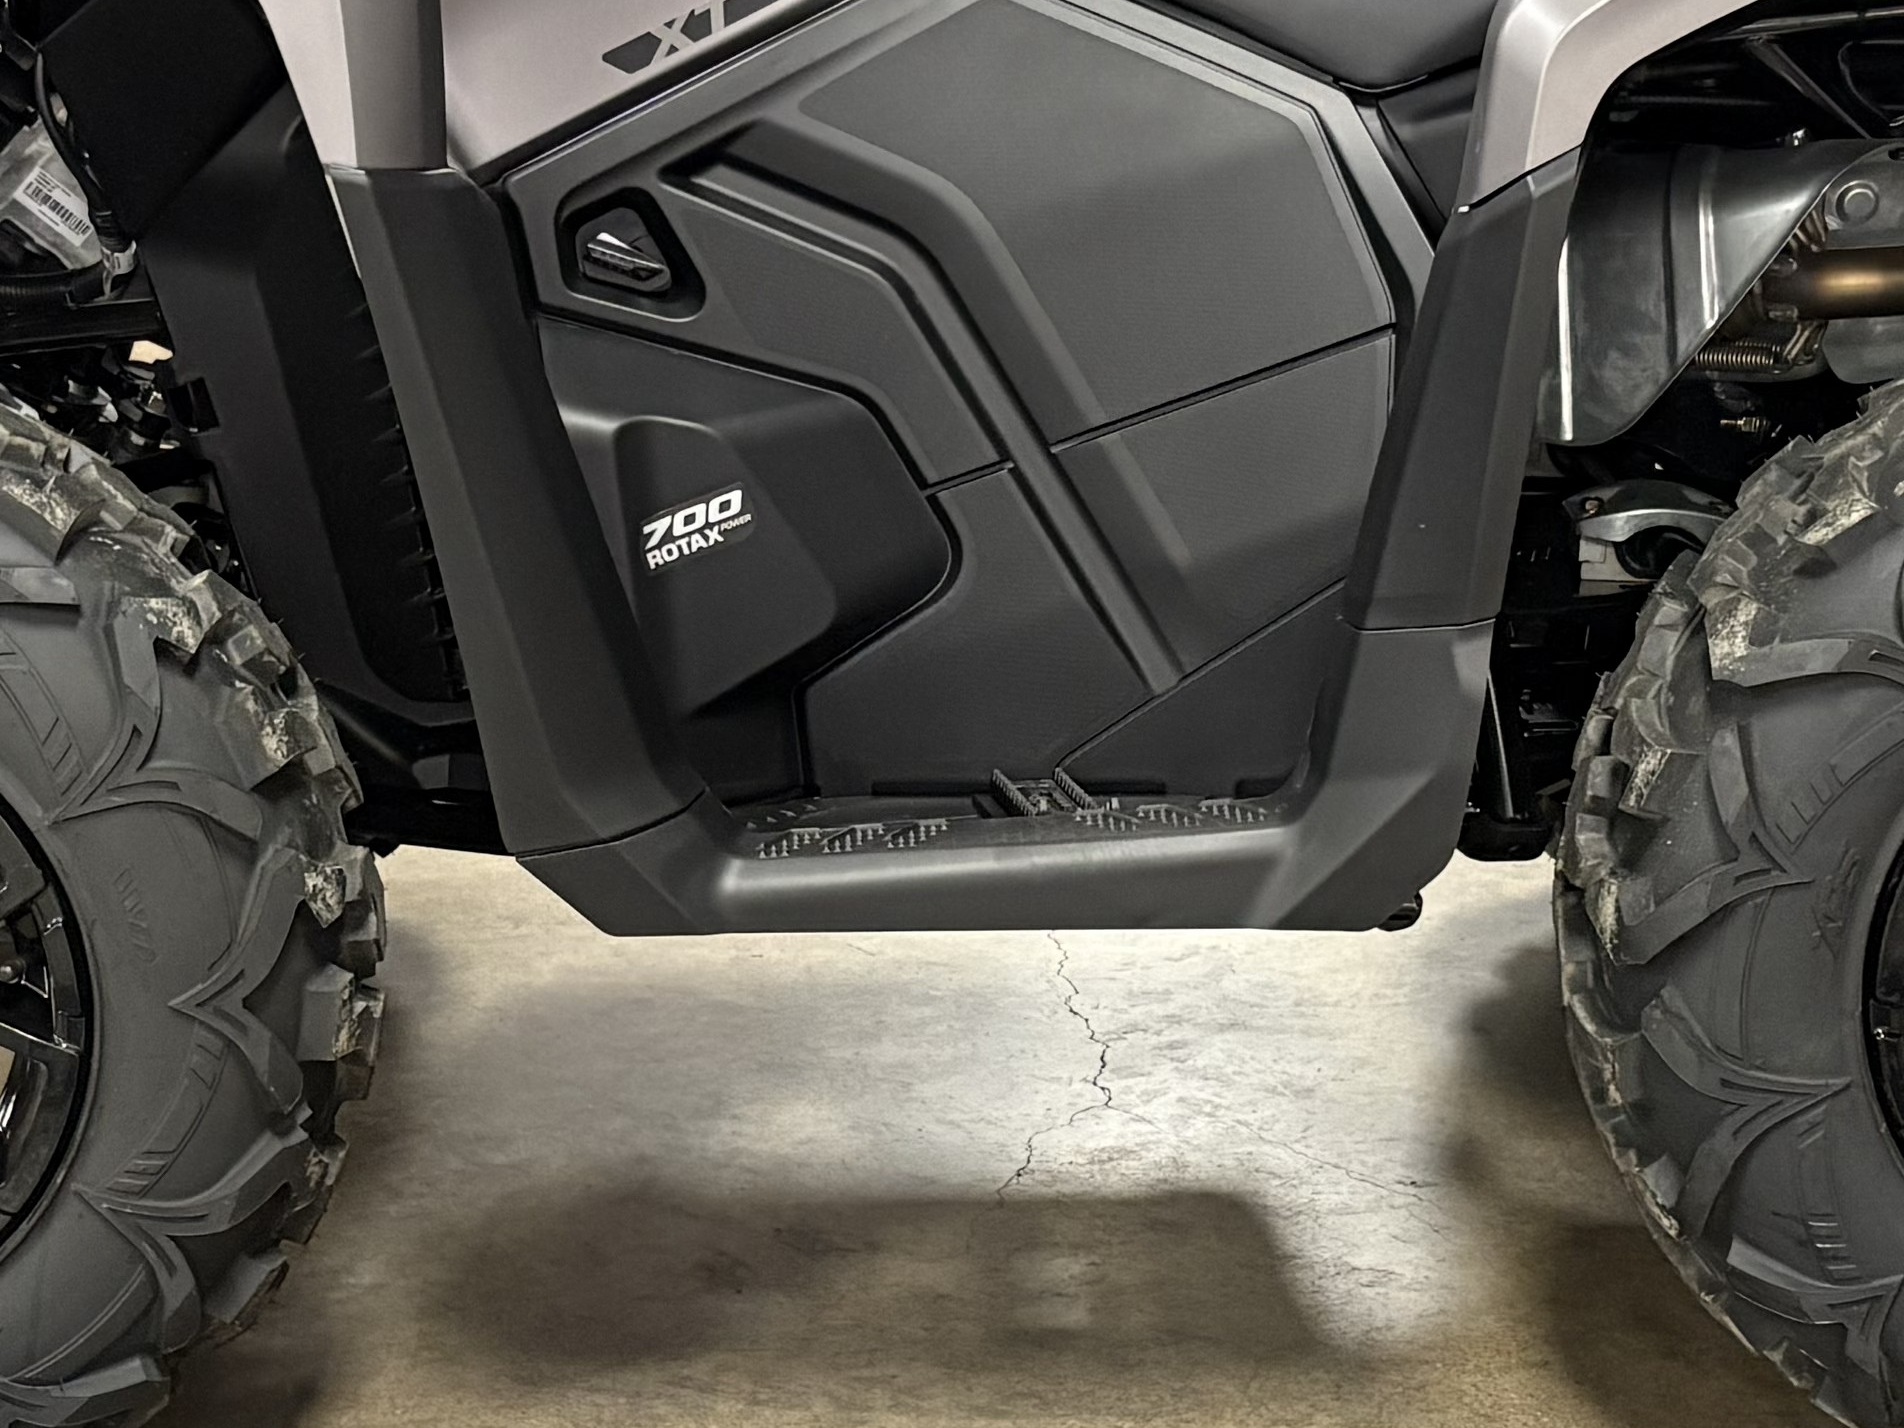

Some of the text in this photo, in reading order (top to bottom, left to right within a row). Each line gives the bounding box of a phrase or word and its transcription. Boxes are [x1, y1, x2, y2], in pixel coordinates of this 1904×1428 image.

[642, 489, 743, 551] 700
[720, 513, 752, 532] POWER
[646, 524, 725, 571] ROTAX
